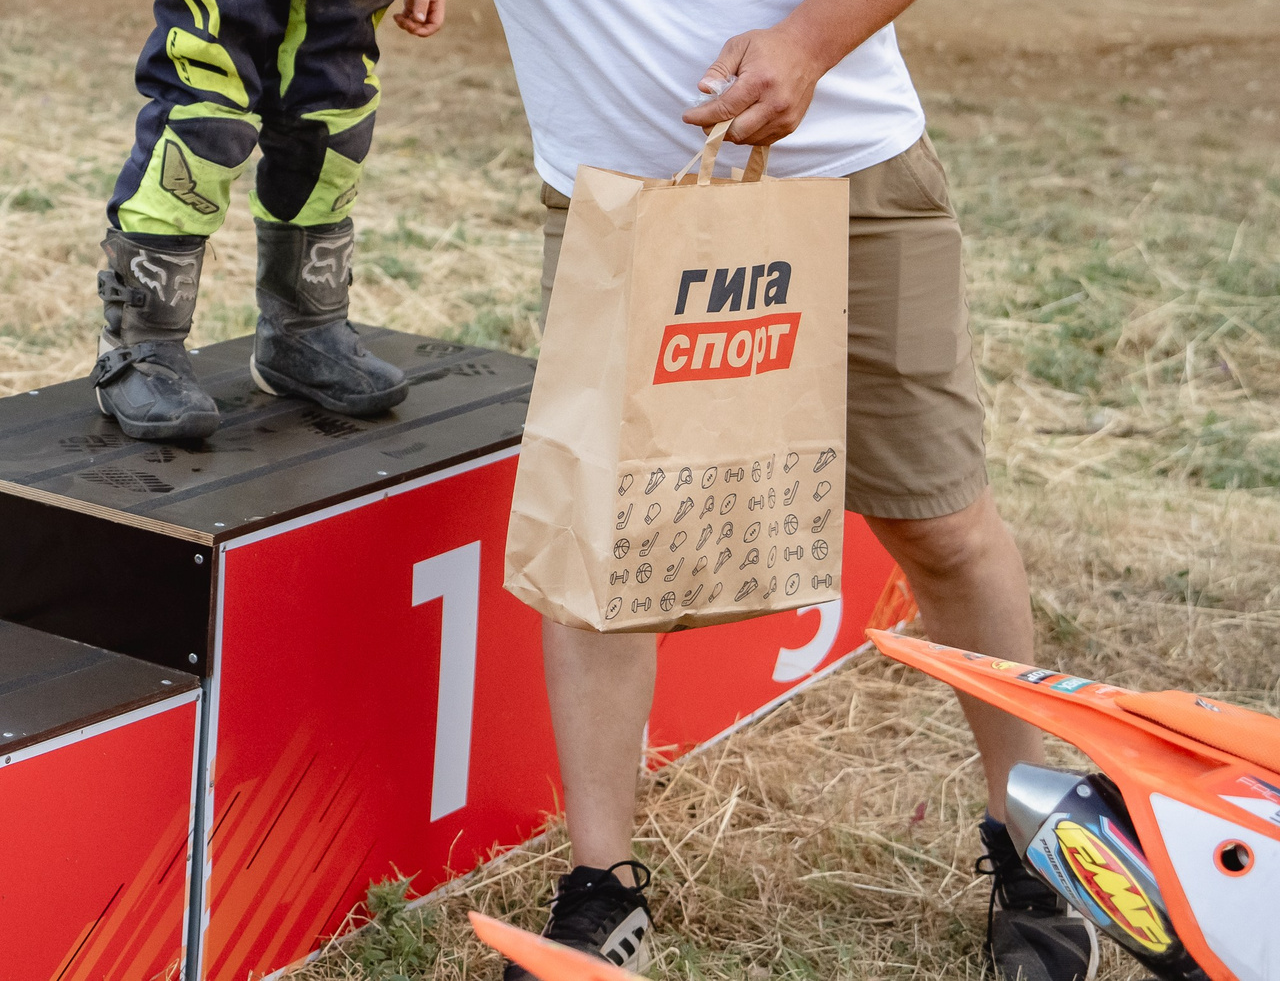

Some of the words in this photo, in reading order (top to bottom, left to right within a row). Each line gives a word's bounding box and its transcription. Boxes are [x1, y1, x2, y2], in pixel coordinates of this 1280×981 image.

[170, 29, 193, 86] PLST
[173, 189, 220, 215] UFO
[412, 540, 481, 823] 1
[1054, 827, 1172, 945] FMF
